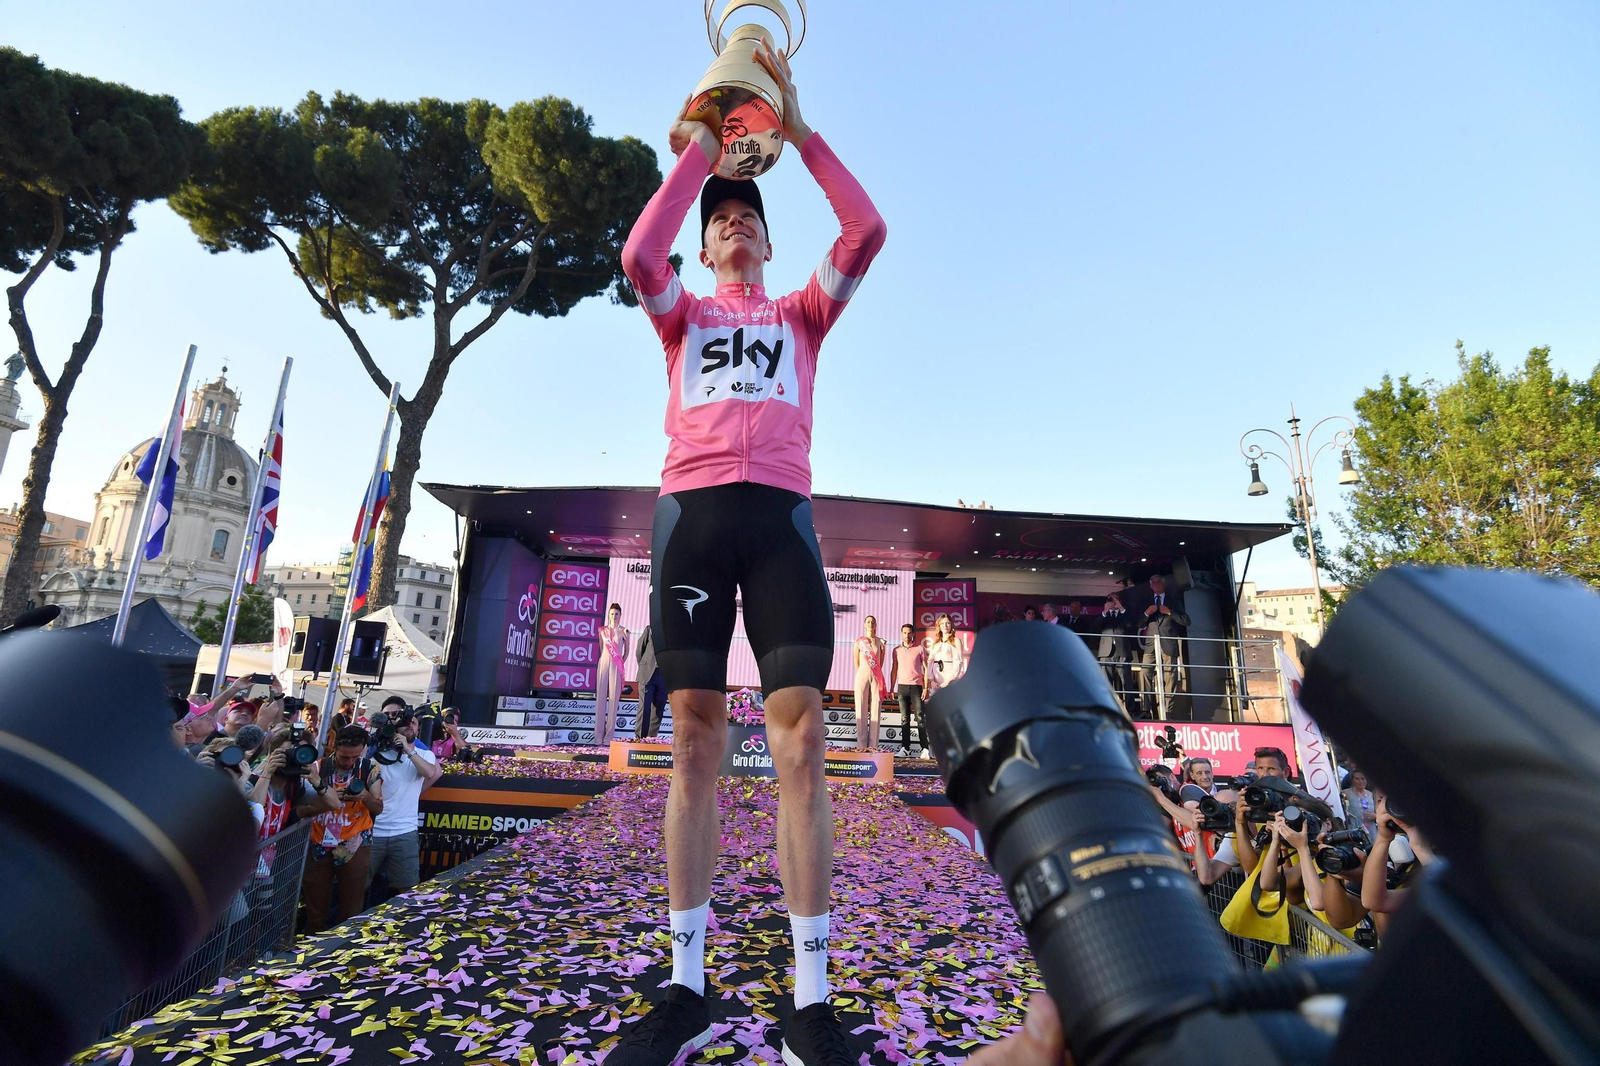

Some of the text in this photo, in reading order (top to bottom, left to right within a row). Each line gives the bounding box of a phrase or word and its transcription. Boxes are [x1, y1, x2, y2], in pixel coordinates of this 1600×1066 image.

[701, 327, 784, 379] sky
[559, 536, 640, 547] enel
[854, 549, 933, 560] enel
[627, 562, 651, 574] La Gazz
[551, 569, 601, 588] enel
[826, 571, 898, 586] La Gazzetta dello Sport
[920, 582, 969, 602] enel
[548, 593, 598, 612] enel
[545, 618, 596, 637] enel
[542, 643, 593, 662] enel
[539, 668, 591, 688] enel
[547, 700, 595, 710] Alfa Romeo
[561, 715, 580, 726] Alfa
[471, 730, 528, 742] Alfa Romeo
[832, 727, 851, 737] Alfa
[1167, 726, 1201, 750] ello
[1200, 726, 1242, 755] Sport
[636, 753, 673, 762] NAMEDSPO
[733, 754, 773, 768] Giro d'Italia
[1208, 758, 1221, 768] ita
[829, 762, 872, 771] NAMEDSPORT
[671, 929, 696, 948] ky
